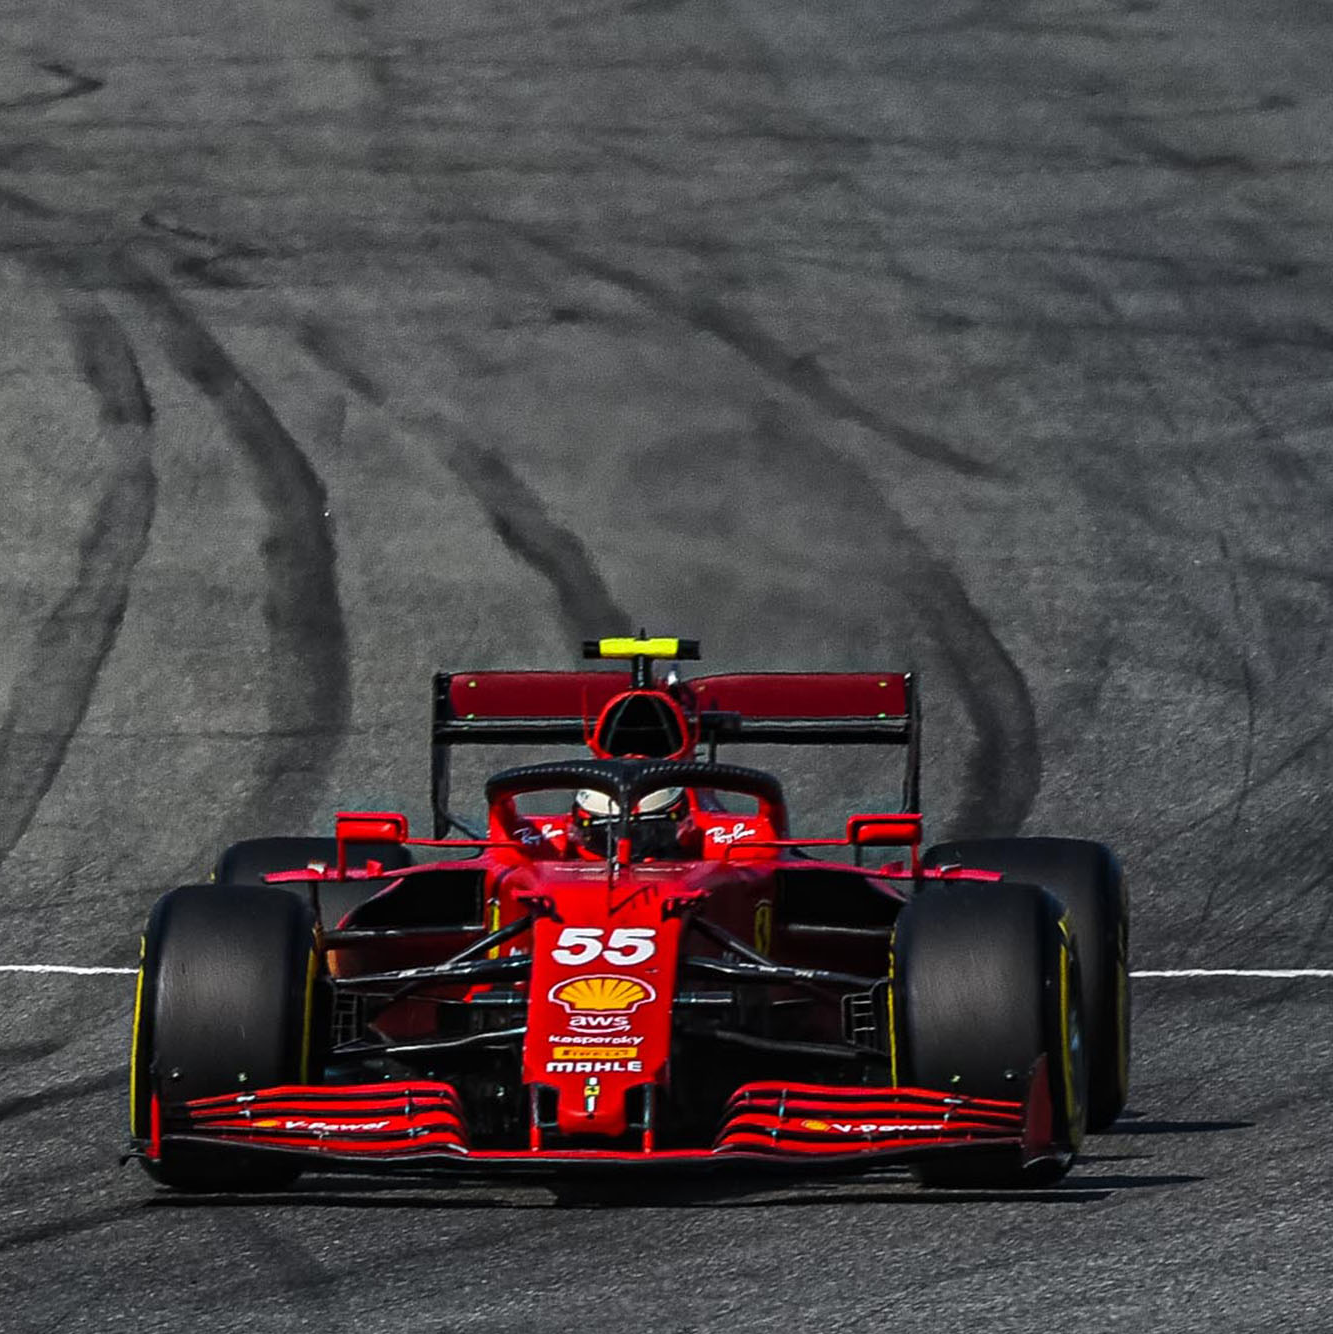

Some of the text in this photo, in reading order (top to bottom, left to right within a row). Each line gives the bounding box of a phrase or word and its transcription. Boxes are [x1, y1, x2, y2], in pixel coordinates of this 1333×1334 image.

[551, 928, 656, 966] 55
[569, 1016, 630, 1026] aws
[548, 1035, 645, 1045] kaspersky
[546, 1061, 643, 1073] MAHLE
